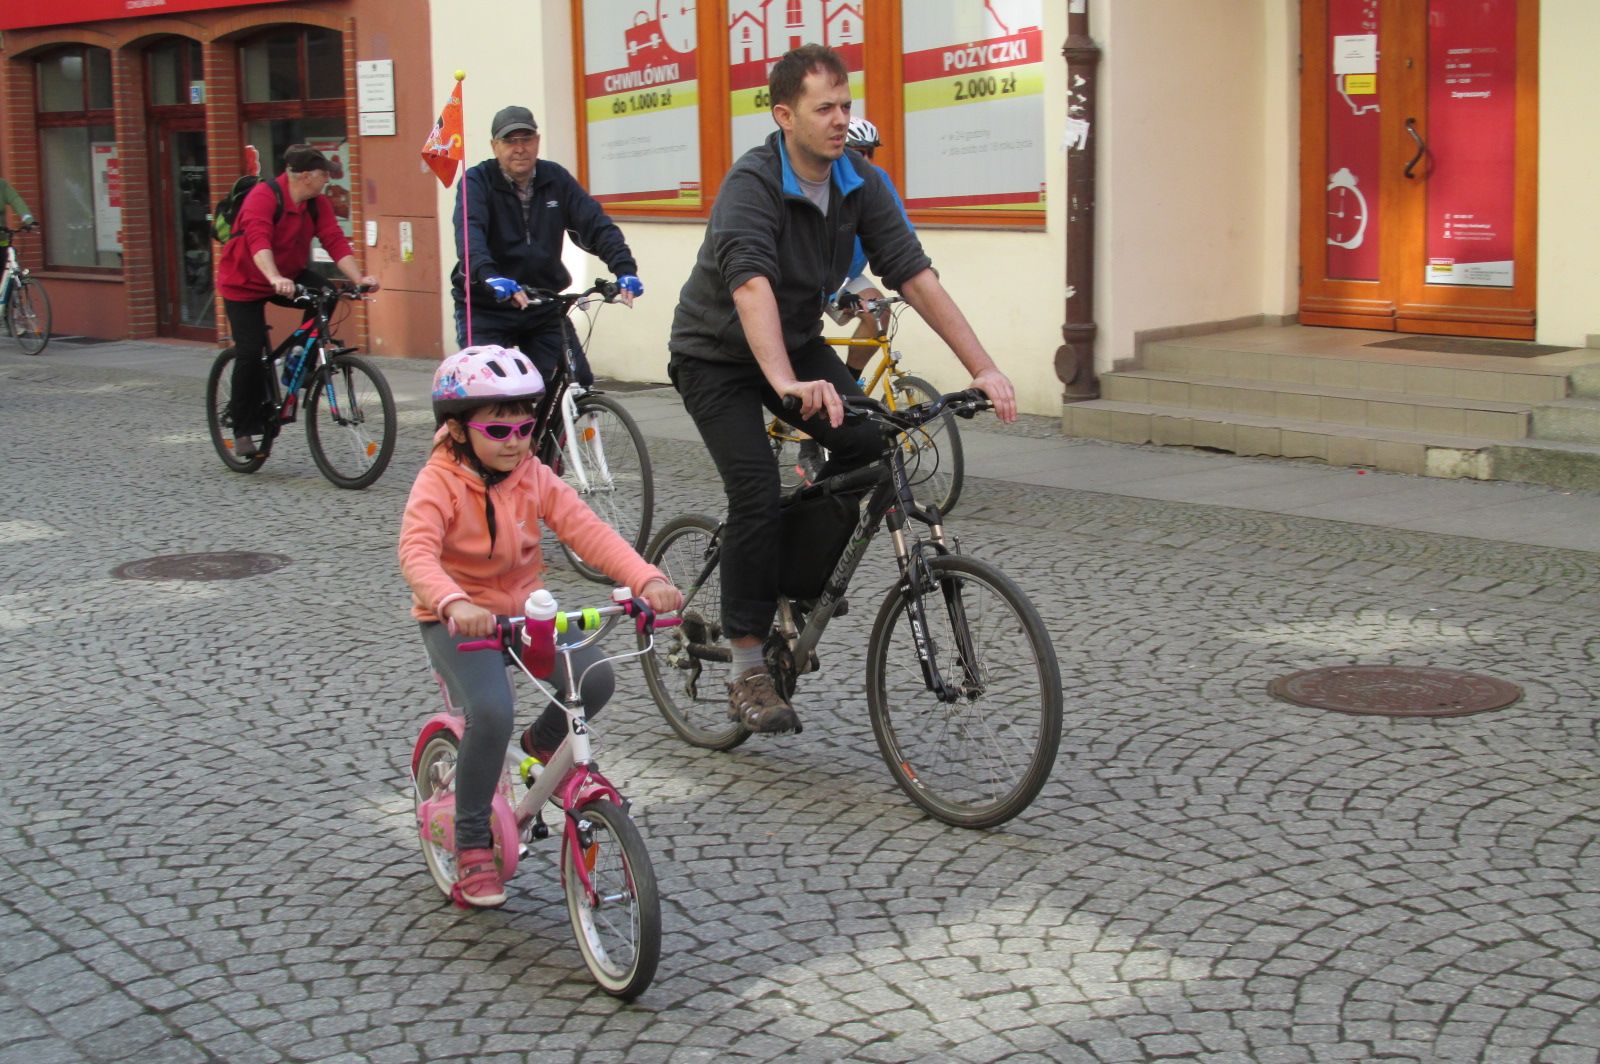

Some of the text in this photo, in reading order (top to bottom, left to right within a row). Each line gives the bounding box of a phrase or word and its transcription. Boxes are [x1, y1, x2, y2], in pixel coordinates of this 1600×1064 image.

[943, 39, 1028, 71] POŻYCZKI
[604, 63, 680, 92] CHWILÓWKI
[954, 72, 1017, 100] 2.000 zł
[612, 88, 672, 114] do 1.000 zł
